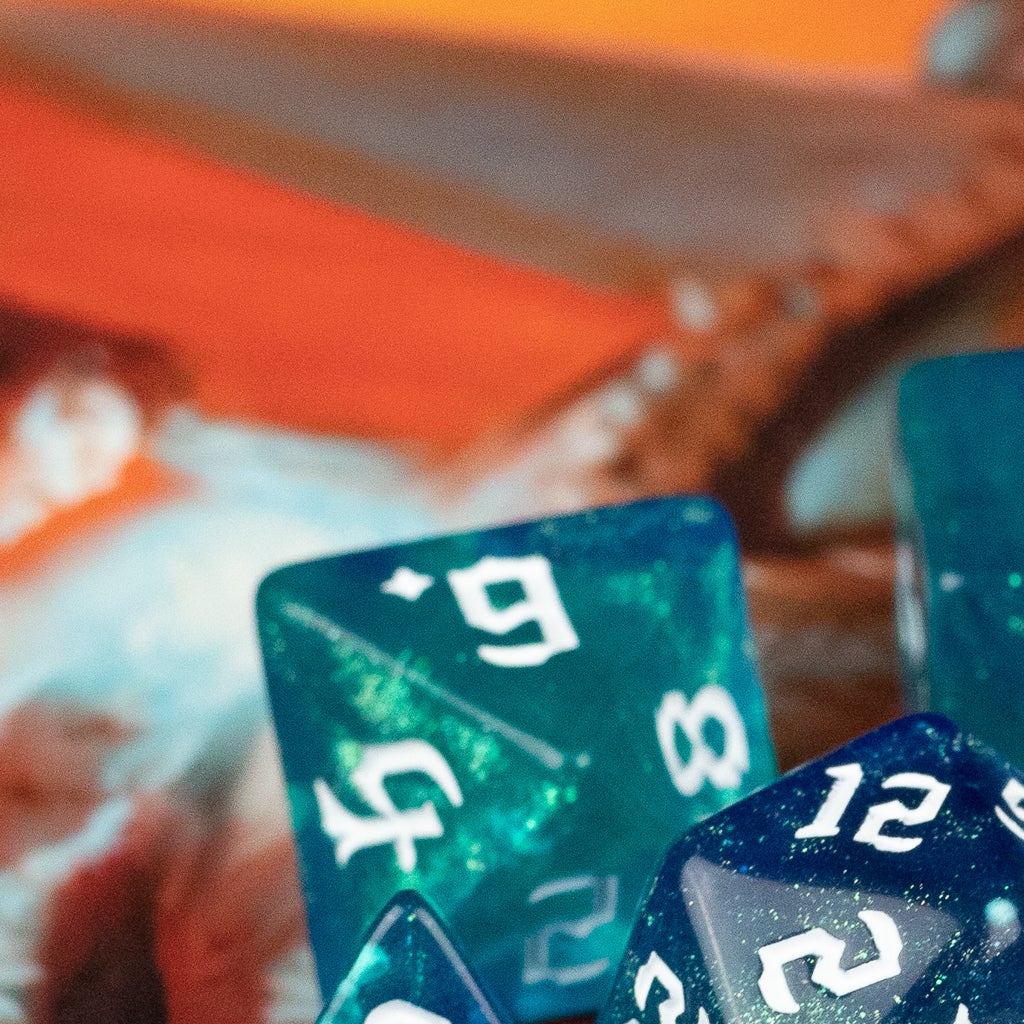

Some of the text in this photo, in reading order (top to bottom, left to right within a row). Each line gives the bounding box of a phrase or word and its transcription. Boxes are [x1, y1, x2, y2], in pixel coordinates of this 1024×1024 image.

[656, 684, 750, 797] 8
[314, 739, 463, 873] 4
[795, 763, 952, 853] 12
[757, 909, 904, 1015] 2
